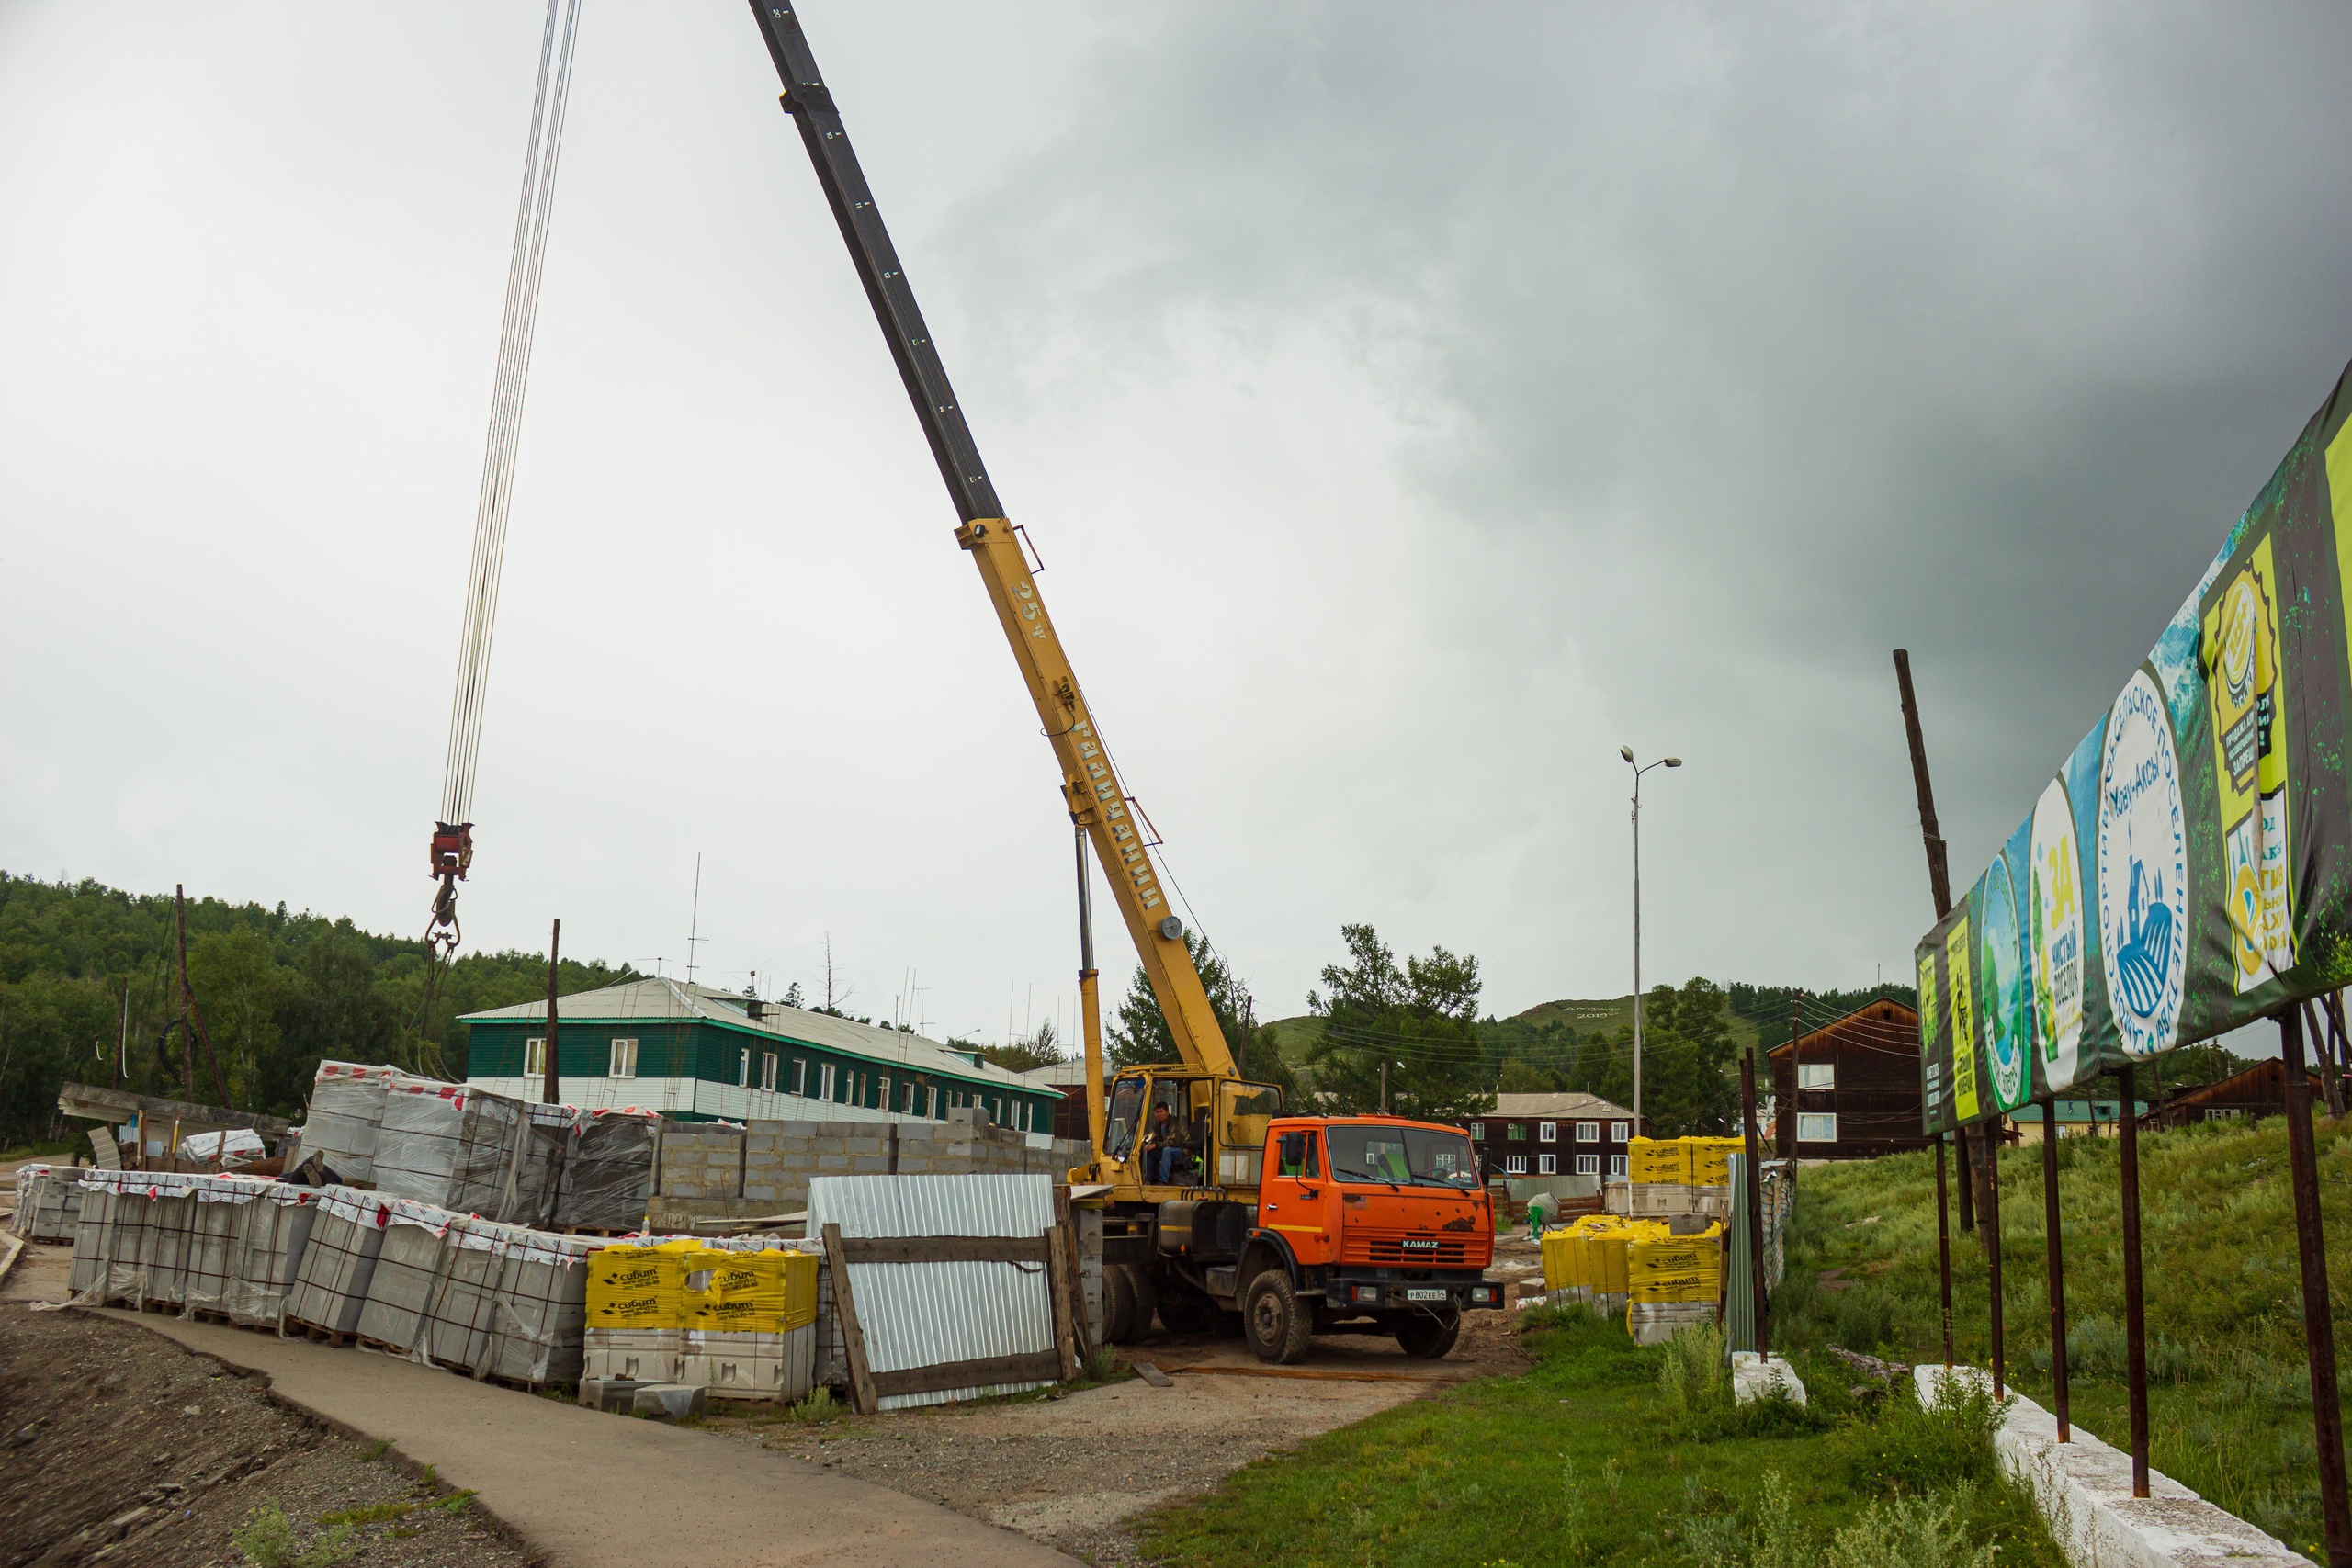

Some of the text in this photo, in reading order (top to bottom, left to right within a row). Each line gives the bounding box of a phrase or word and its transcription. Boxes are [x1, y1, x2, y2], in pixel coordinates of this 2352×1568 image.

[772, 7, 782, 18] 20
[826, 131, 833, 140] 10
[1011, 581, 1044, 621] 25
[2227, 601, 2247, 660] 18+
[2109, 750, 2160, 821] Хову-Аксы
[2101, 738, 2117, 978] СПОРТИВОЕ
[2114, 685, 2157, 741] СЕЛЬСКОЕ
[2157, 725, 2184, 976] ПОСЕЛЕНИЕ
[2048, 834, 2075, 931] ЗА
[2052, 919, 2077, 971] ЧИСТЫЙ
[1402, 1240, 1439, 1248] KAMAZ
[620, 1269, 657, 1280] сибит
[718, 1271, 755, 1282] ибит
[617, 1298, 657, 1309] сибит
